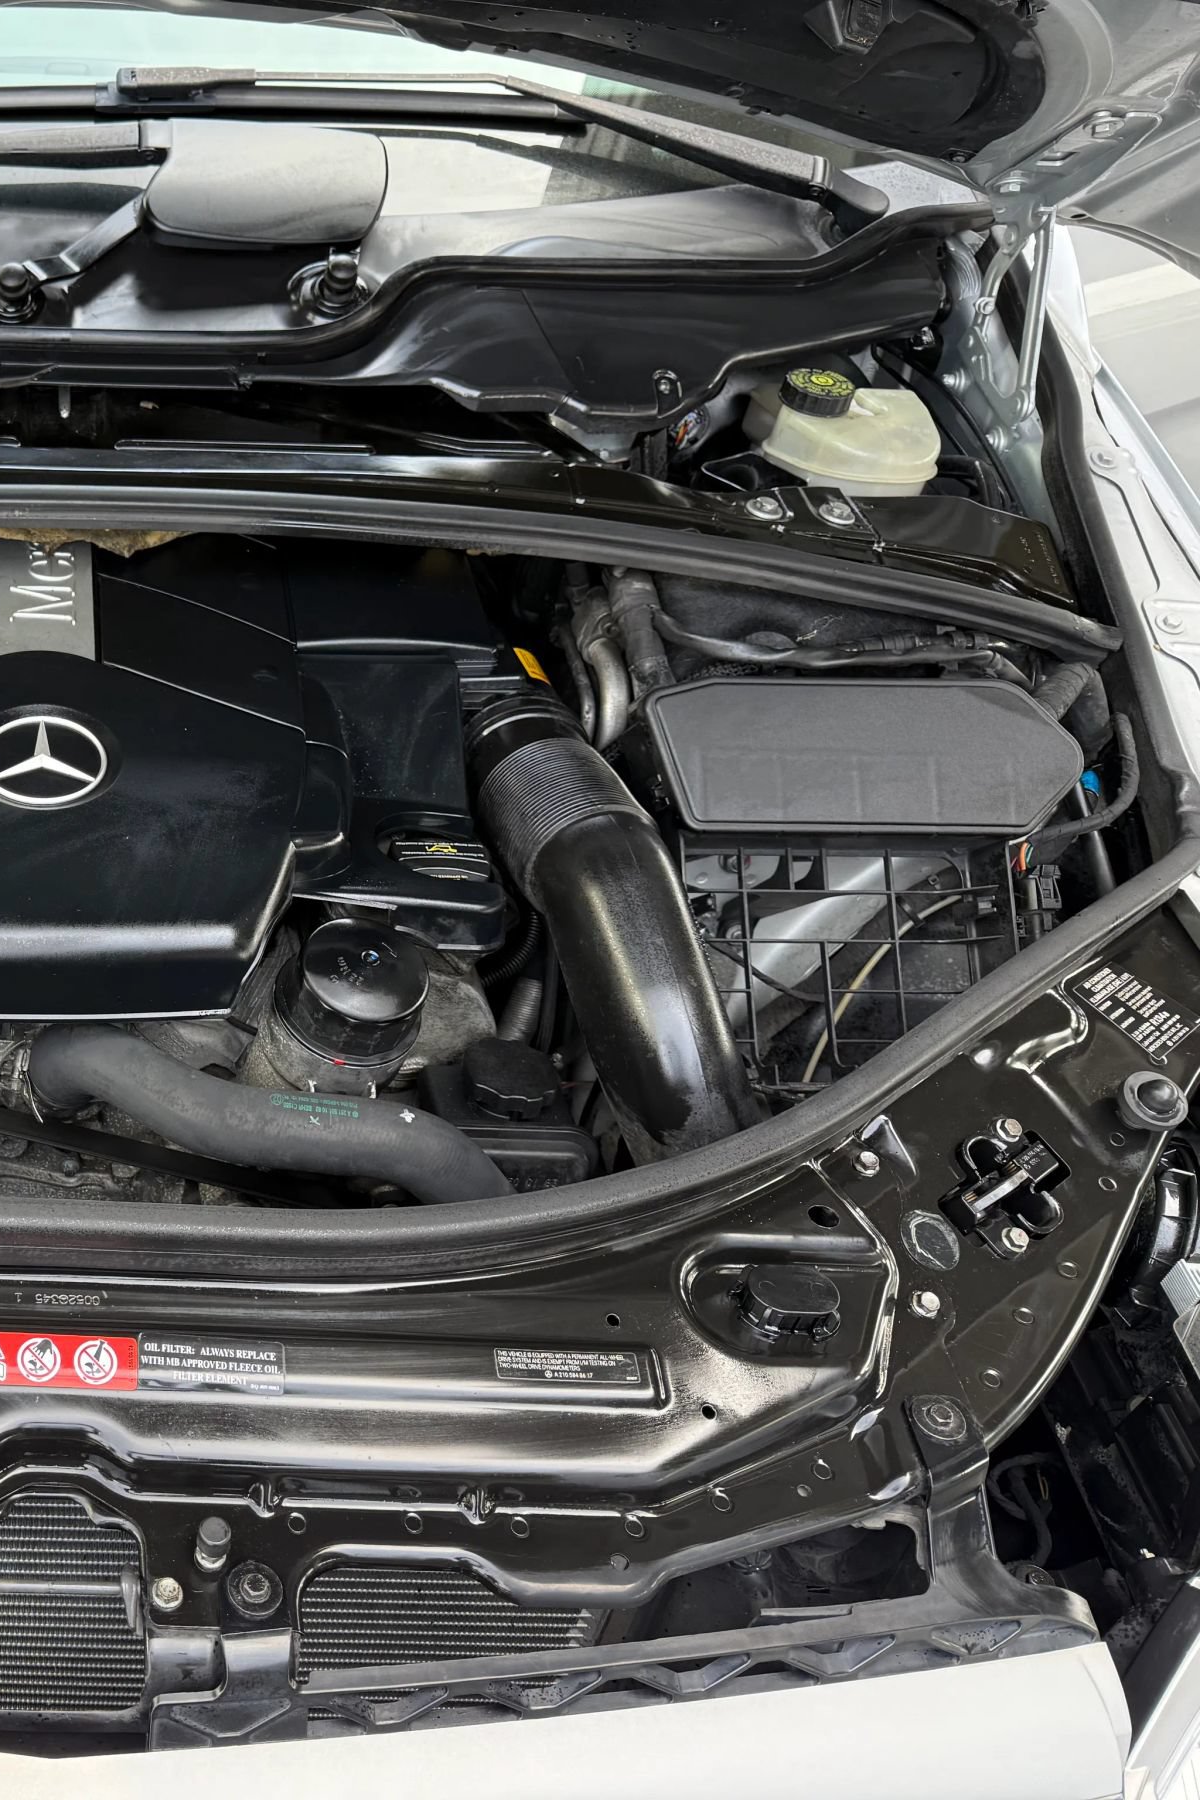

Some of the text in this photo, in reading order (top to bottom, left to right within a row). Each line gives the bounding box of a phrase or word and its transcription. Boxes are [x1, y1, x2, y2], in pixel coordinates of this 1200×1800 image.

[144, 1343, 276, 1361] OIL FILTER: ALWAYS REPLACE
[141, 1355, 164, 1366] WITH
[166, 1357, 180, 1366] MB
[181, 1358, 227, 1370] APPROVED
[229, 1362, 263, 1373] FLEECE
[264, 1365, 281, 1374] OIL
[173, 1371, 248, 1385] FILTER ELEMENT
